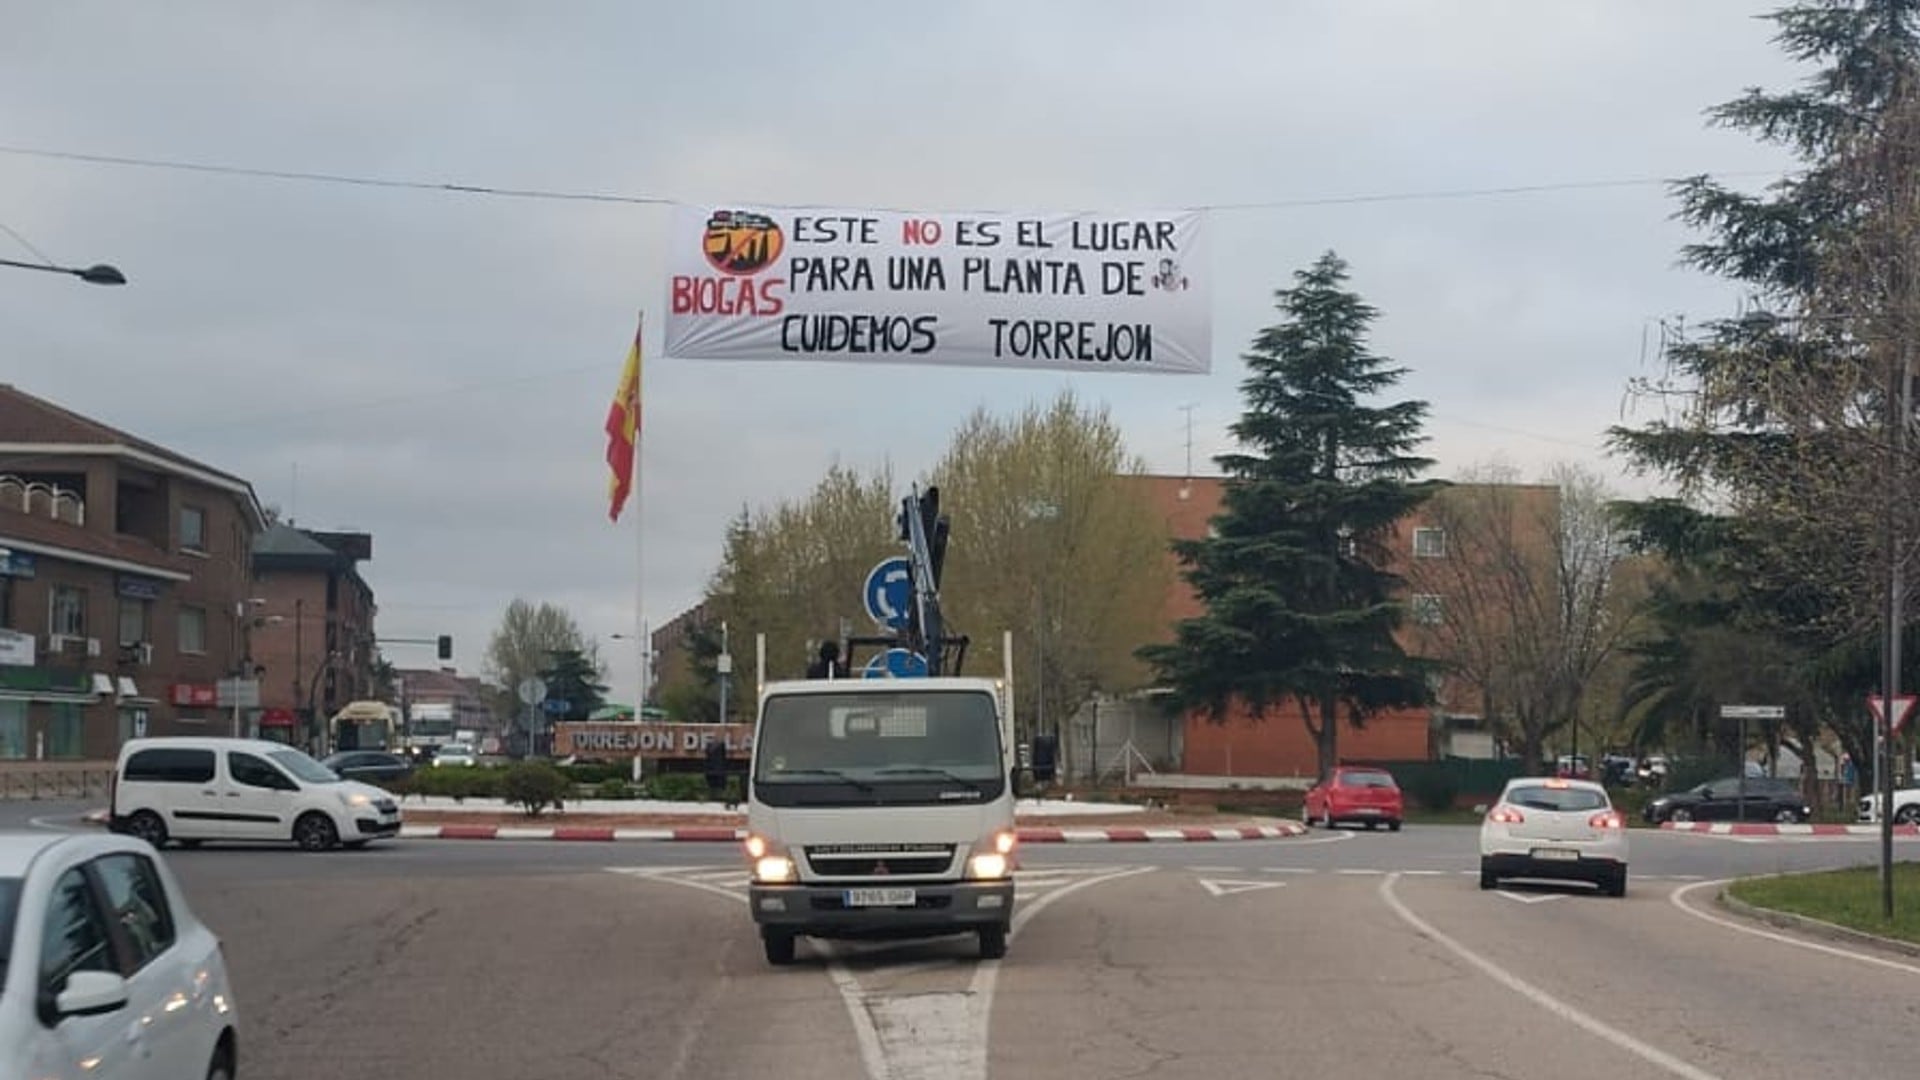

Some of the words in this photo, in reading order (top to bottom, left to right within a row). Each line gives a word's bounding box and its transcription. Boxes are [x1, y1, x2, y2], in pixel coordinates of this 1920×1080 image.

[793, 217, 879, 243] ESTE
[903, 220, 941, 245] NO
[955, 221, 1001, 246] ES
[1017, 221, 1053, 248] EL
[1072, 221, 1177, 250] LUGAR
[789, 256, 874, 292] PARA
[888, 256, 946, 291] UNA
[963, 257, 1085, 295] PLANTA
[1102, 262, 1145, 295] DE
[672, 276, 785, 316] BIOGAS
[781, 314, 937, 353] CUIDEMOS
